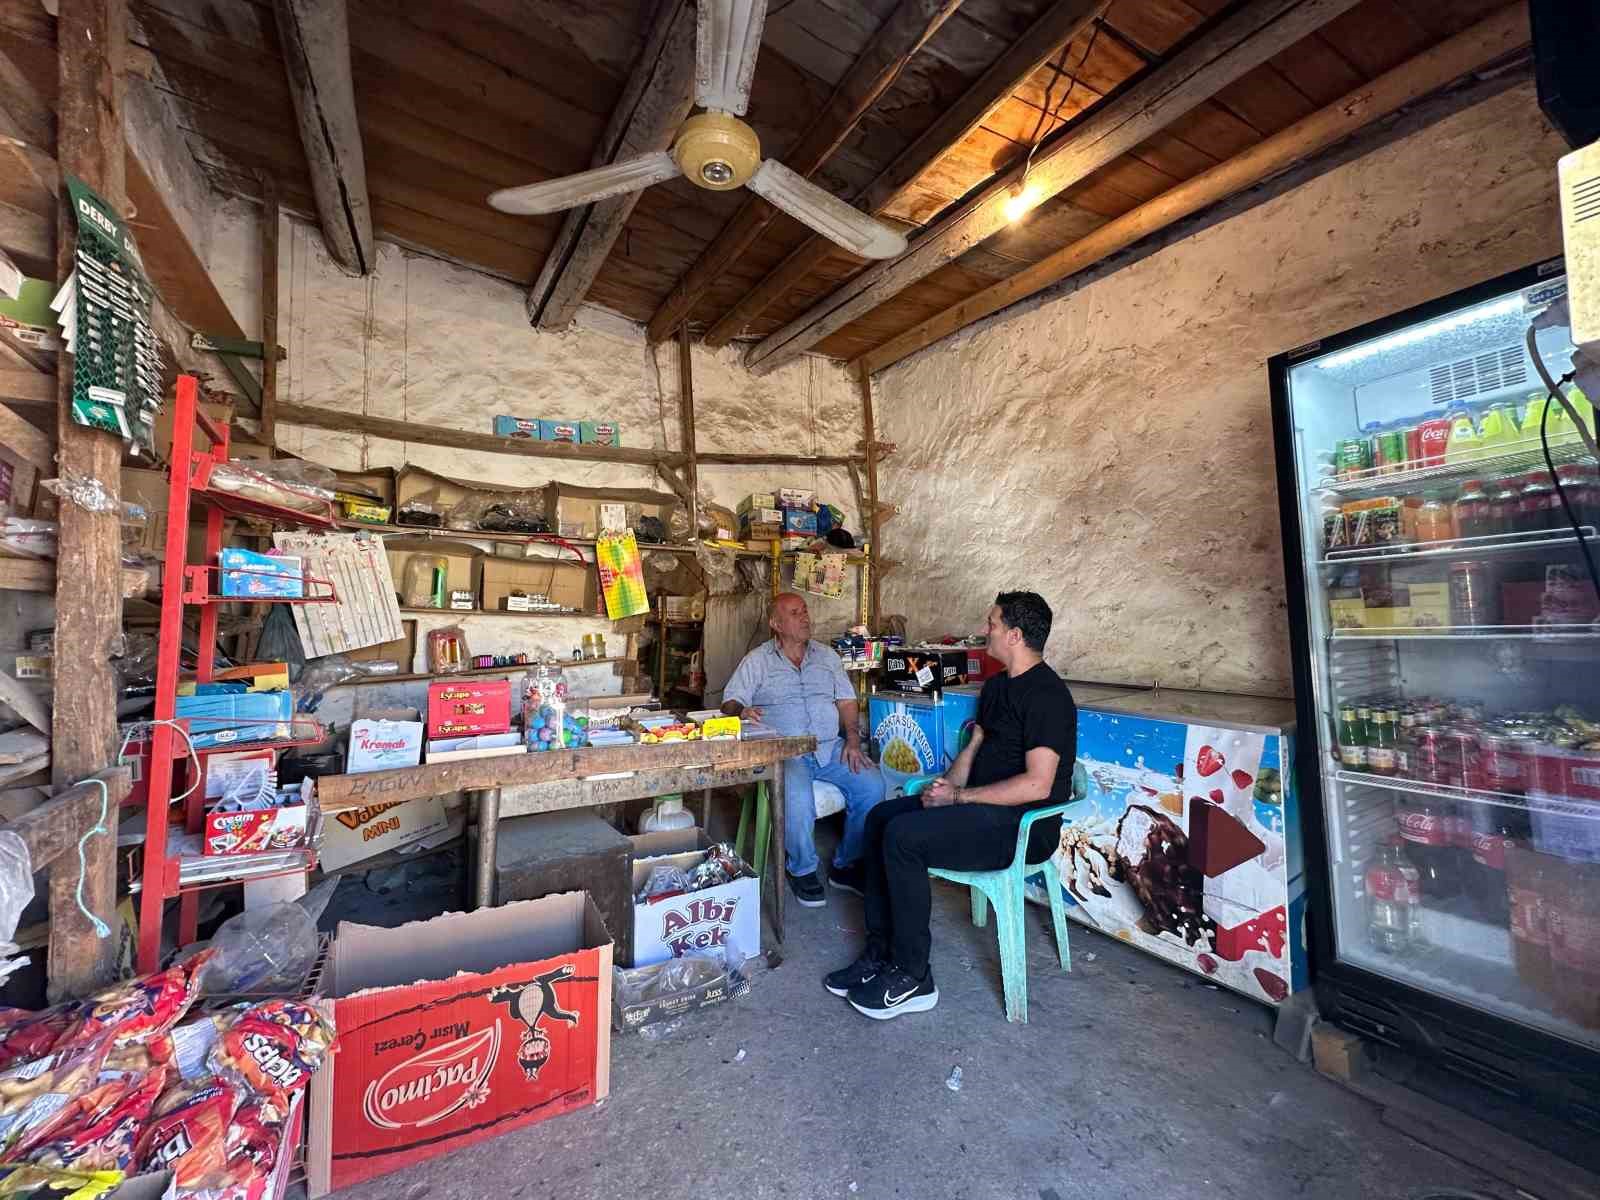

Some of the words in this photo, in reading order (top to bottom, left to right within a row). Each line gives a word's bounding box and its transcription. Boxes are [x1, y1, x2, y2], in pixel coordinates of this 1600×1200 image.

[79, 198, 117, 238] DERBY
[362, 816, 400, 841] MINI
[662, 897, 737, 940] Albi
[668, 926, 730, 959] Kek
[381, 1056, 479, 1110] Paçimo
